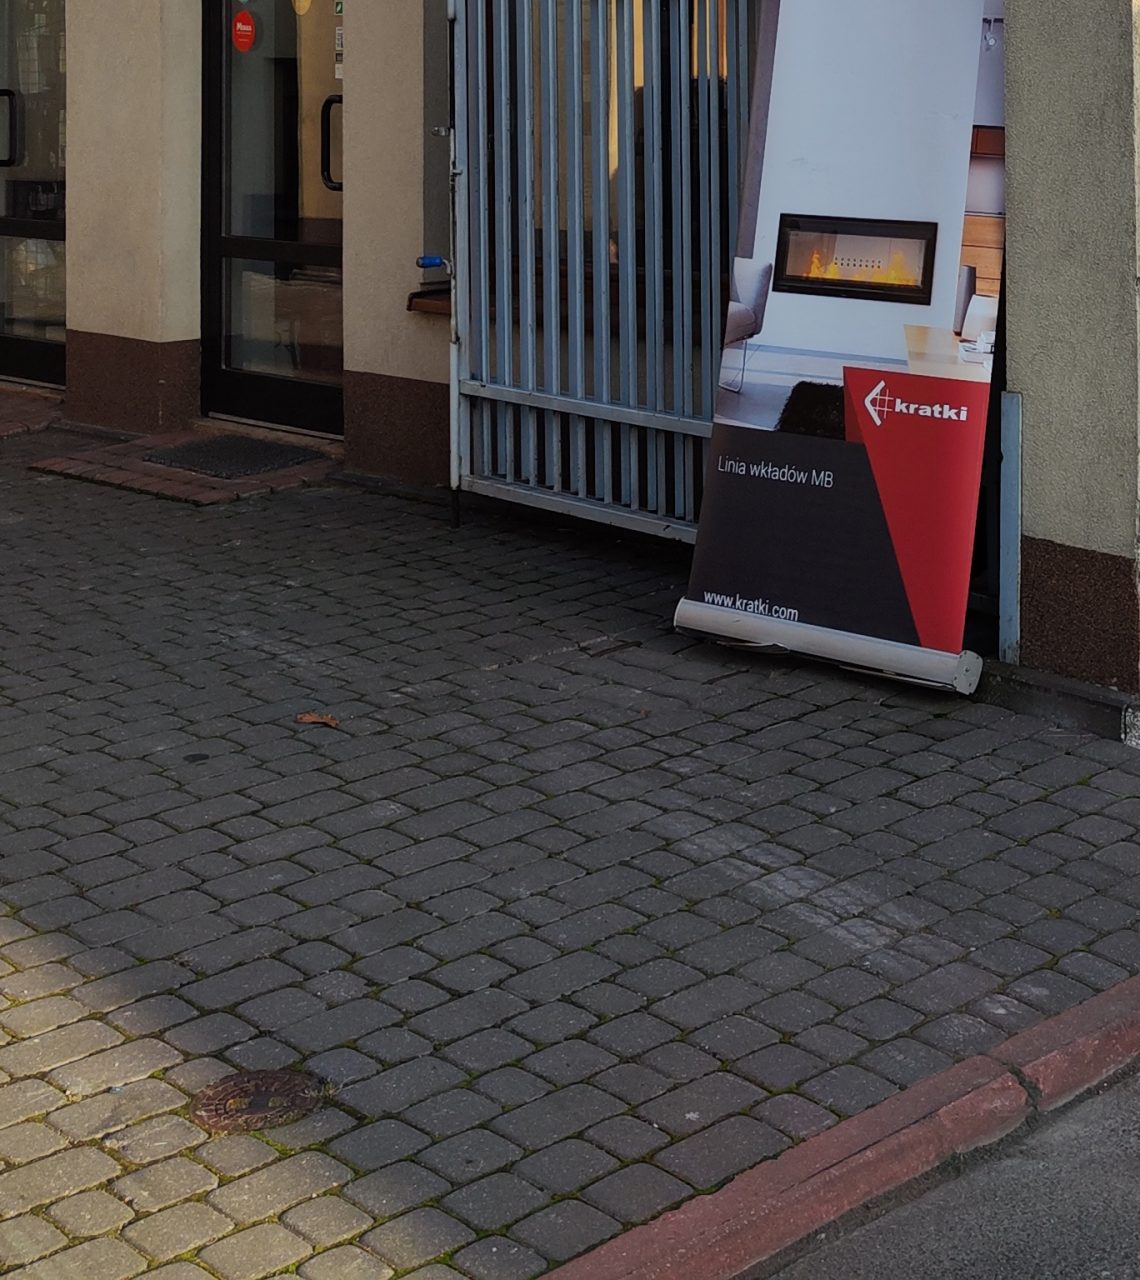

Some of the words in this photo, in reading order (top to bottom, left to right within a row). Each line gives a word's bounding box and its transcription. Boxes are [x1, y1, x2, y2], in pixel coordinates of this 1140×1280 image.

[895, 399, 968, 421] kratki
[717, 455, 746, 475] Linia
[749, 462, 808, 484] wkładów
[811, 469, 834, 488] MB
[704, 591, 799, 621] www.kratki.com
